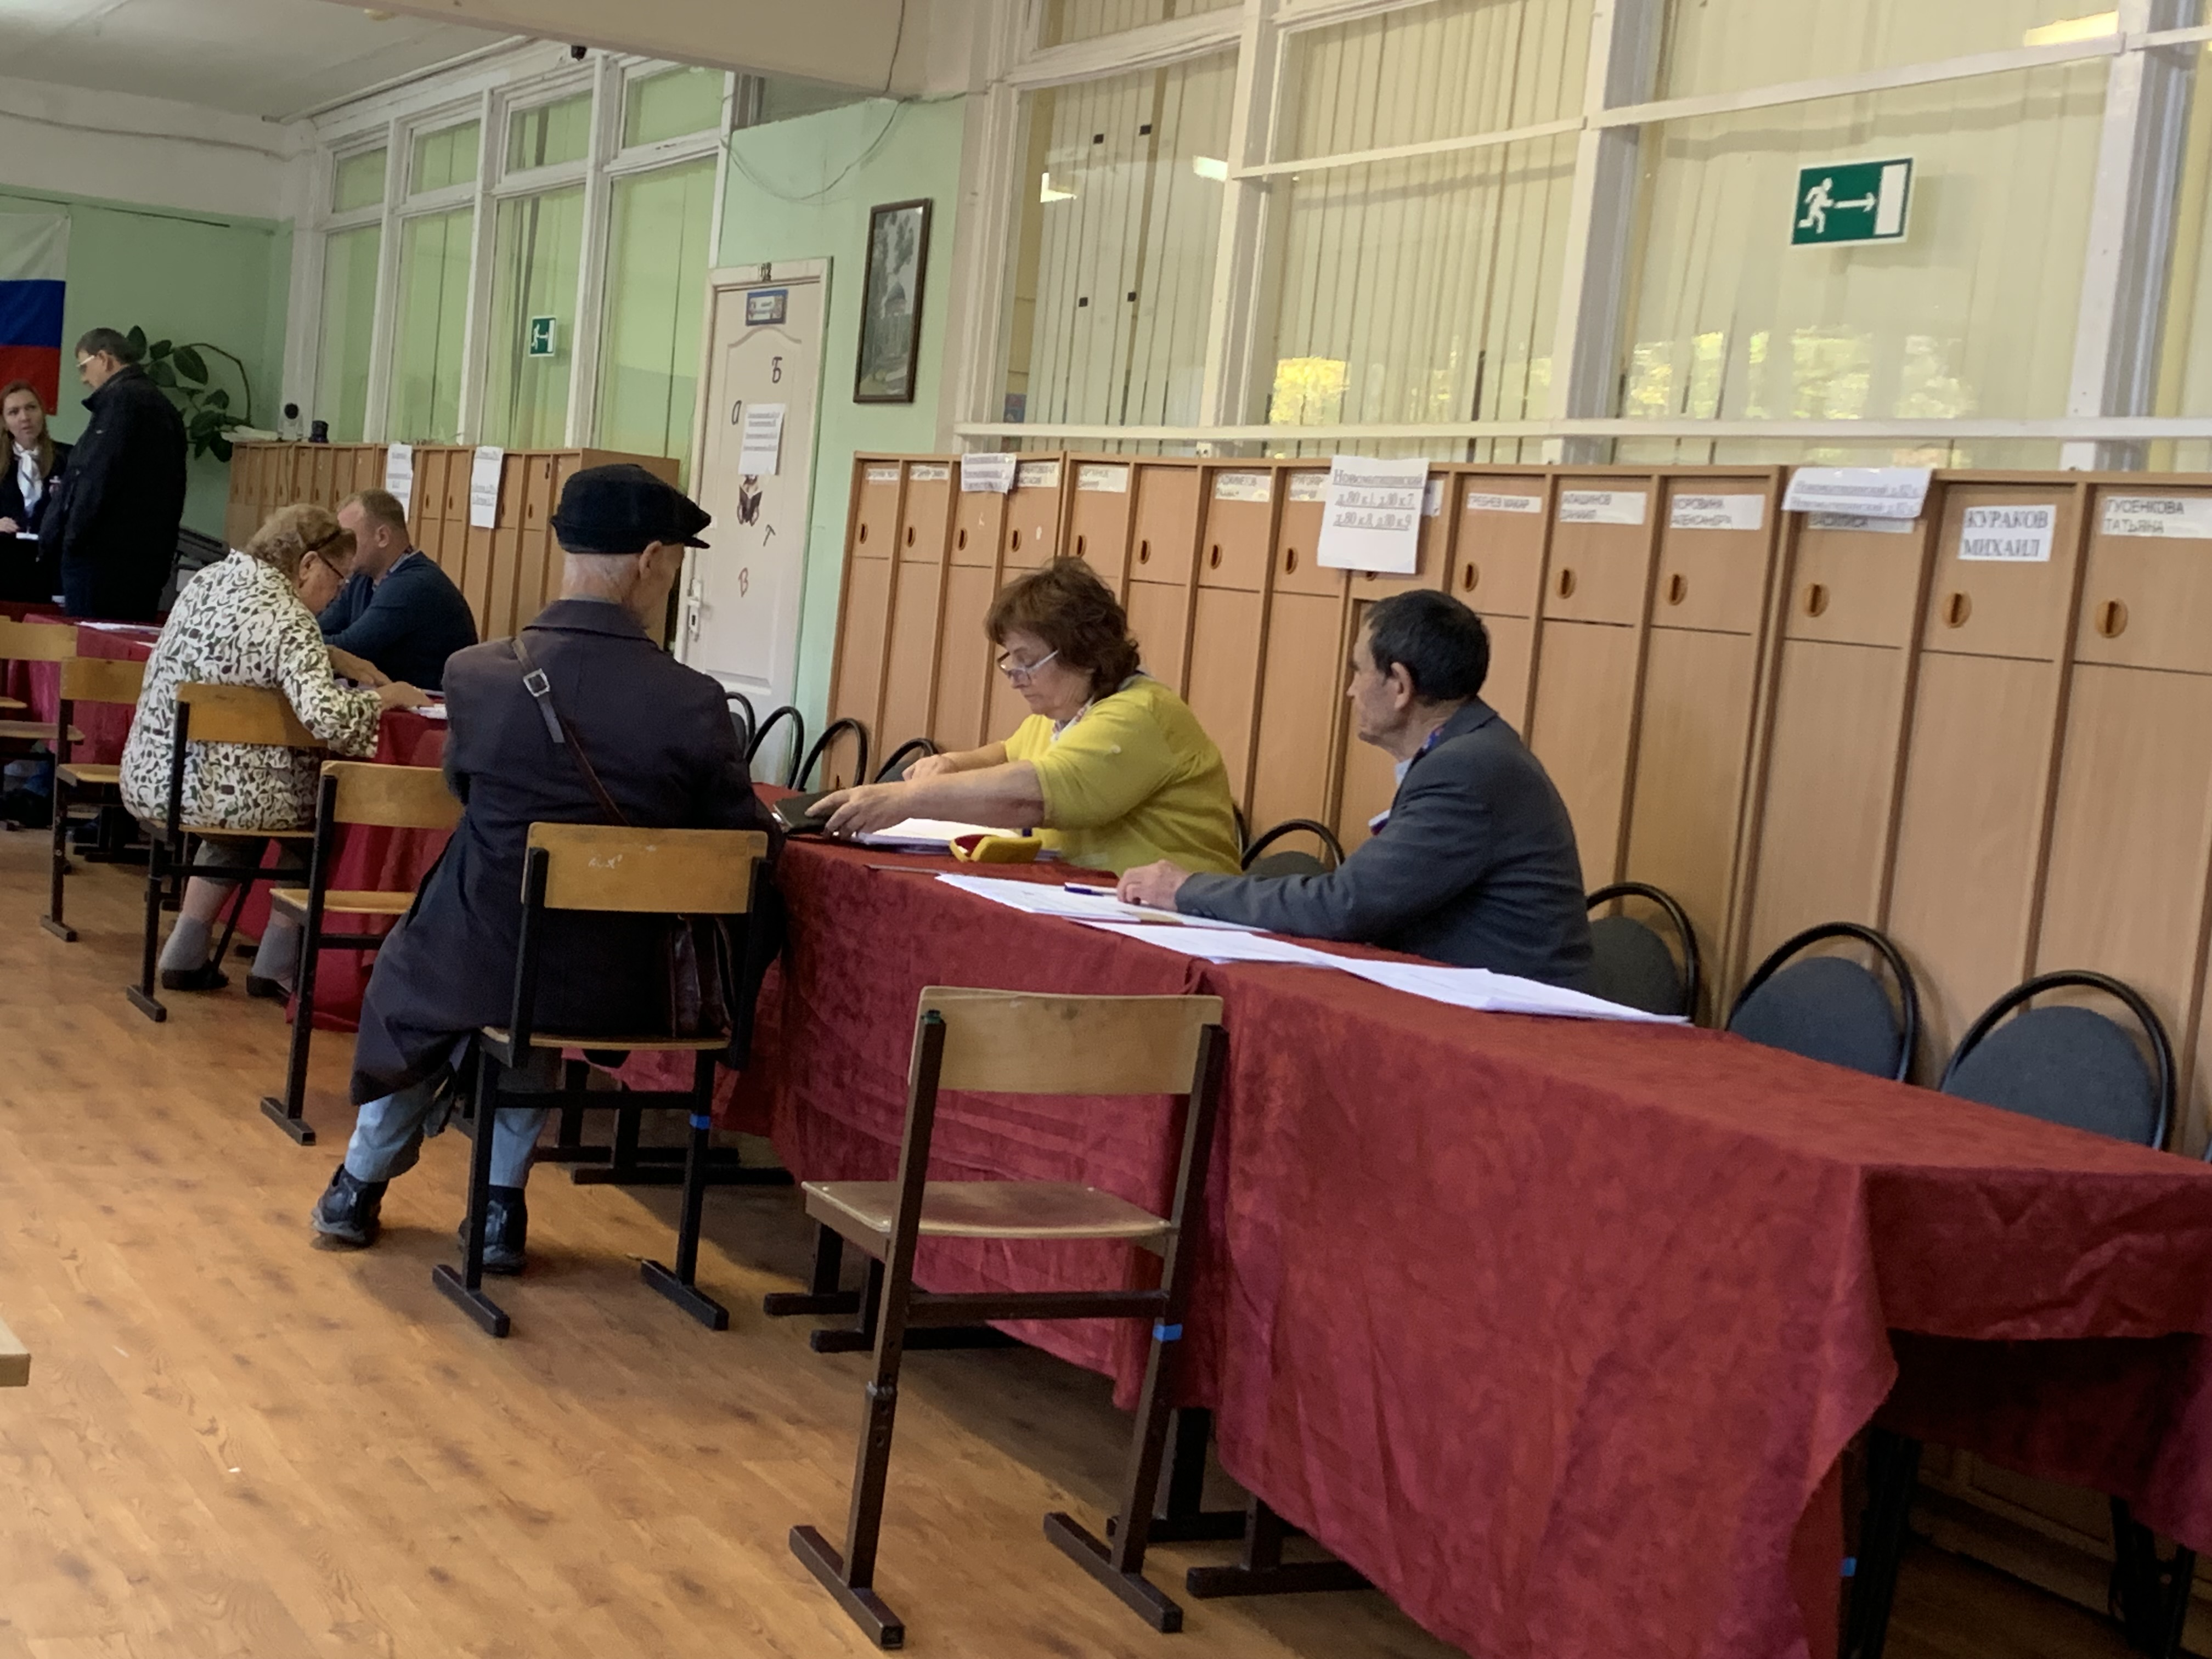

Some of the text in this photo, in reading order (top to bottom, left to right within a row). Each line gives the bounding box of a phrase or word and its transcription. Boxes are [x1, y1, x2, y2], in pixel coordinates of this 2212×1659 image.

[2107, 499, 2185, 514] ГУСЕНКОВА
[1965, 510, 2049, 528] КУРАКОВ
[2105, 518, 2164, 533] ТАТЬЯНА
[1963, 539, 2040, 557] МИХАИЛ
